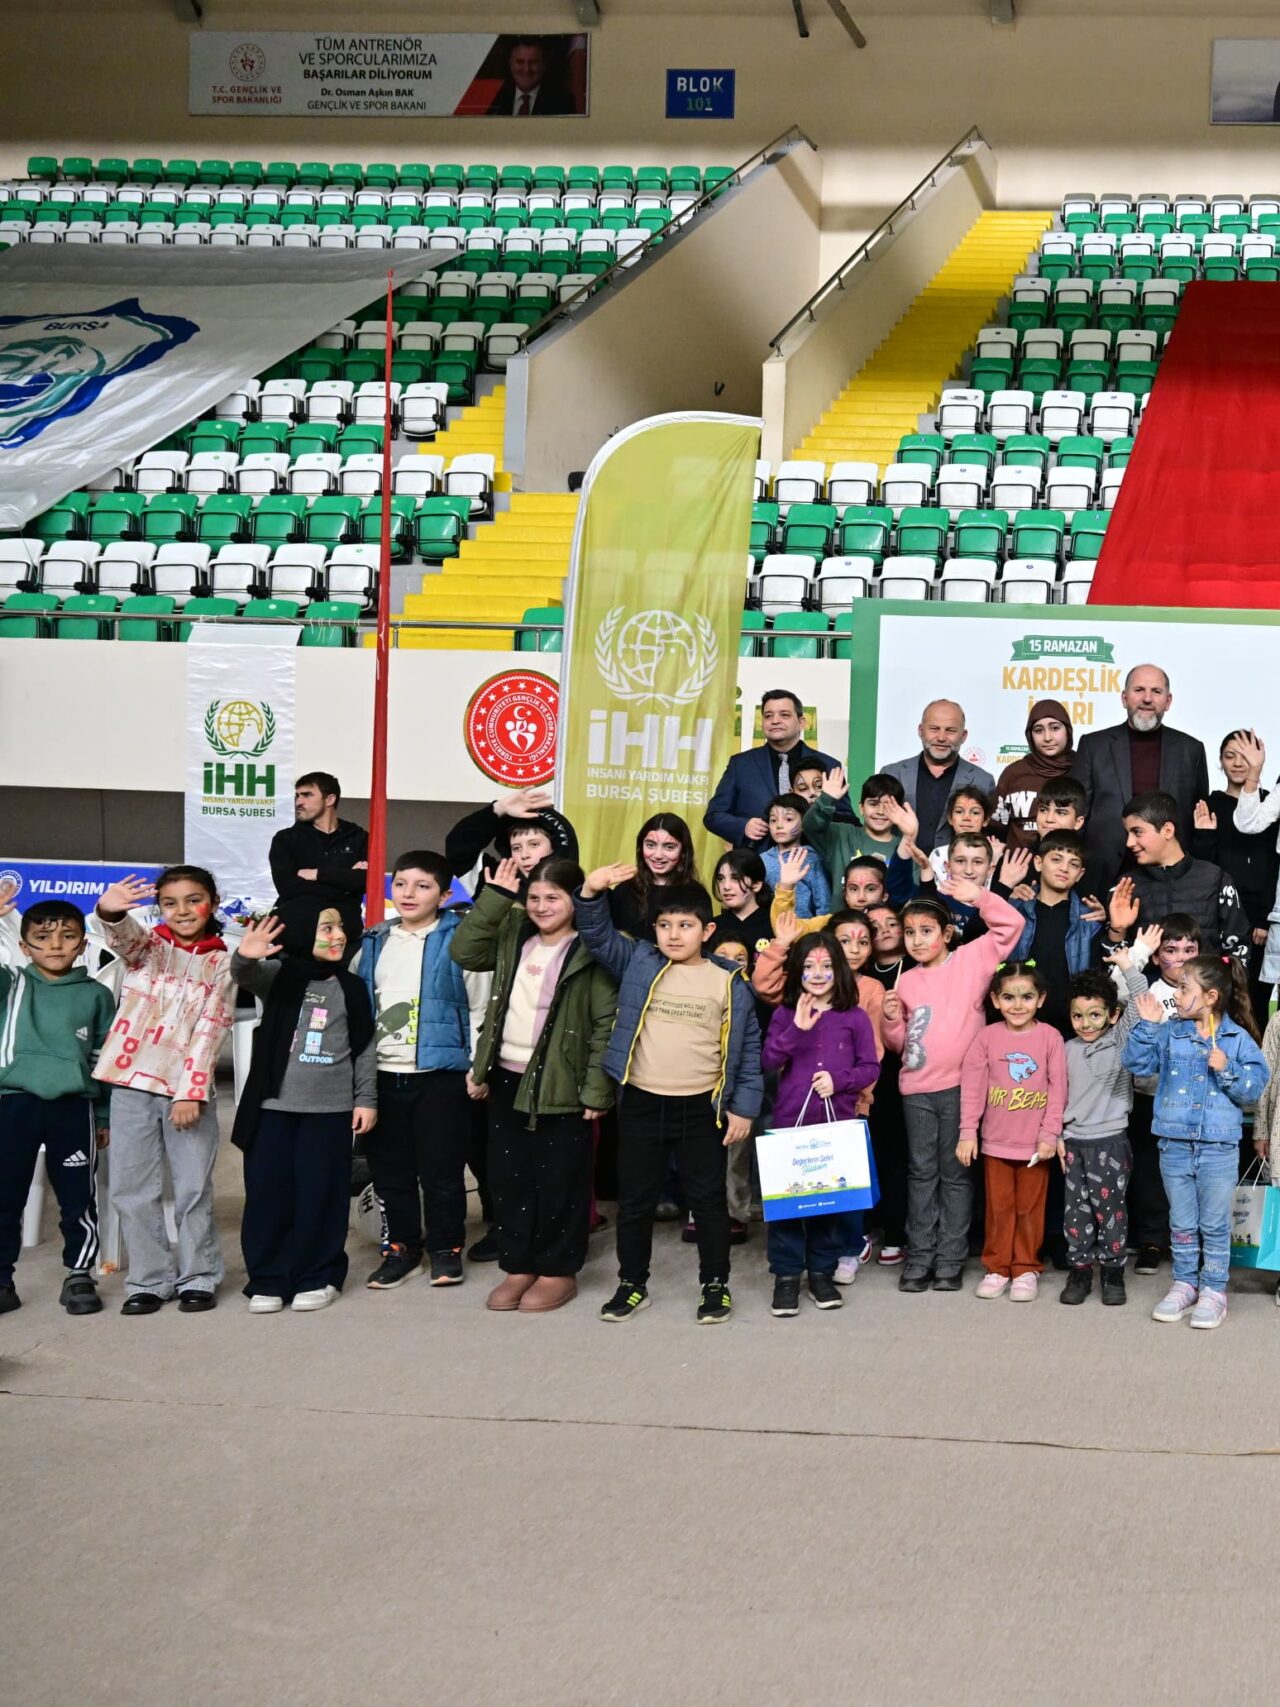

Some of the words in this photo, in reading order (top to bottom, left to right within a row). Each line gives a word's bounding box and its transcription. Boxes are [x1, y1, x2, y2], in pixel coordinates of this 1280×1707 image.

[314, 37, 345, 51] TÜM
[349, 37, 422, 51] ANTRENÖR
[298, 53, 315, 65] VE
[319, 52, 437, 65] SPORCULARIMIZA
[303, 69, 366, 82] BAŞARILAR
[368, 68, 433, 80] DİLİYORUM
[230, 86, 268, 95] GENÇLİK
[677, 77, 724, 92] BLOK
[320, 88, 333, 97] Dr.
[336, 88, 366, 97] Osman
[368, 88, 393, 98] Aşkın
[395, 88, 414, 97] BAK
[212, 96, 234, 104] SPOR
[307, 100, 348, 112] GENÇLİK
[350, 101, 361, 110] VE
[363, 101, 388, 110] SPOR
[390, 101, 426, 111] BAKANI
[43, 320, 110, 332] BURSA
[1028, 639, 1042, 653] 15
[1043, 640, 1098, 654] RAMAZAN
[1002, 665, 1121, 698] KARDEŞLİK
[628, 770, 674, 783] YARDIM
[586, 783, 642, 801] BURSA
[648, 788, 709, 806] ŞUBESİ
[227, 797, 254, 806] YARDIM
[201, 806, 237, 817] BURSA
[239, 807, 276, 819] ŞUBESİ
[29, 879, 105, 895] YILDIRIM
